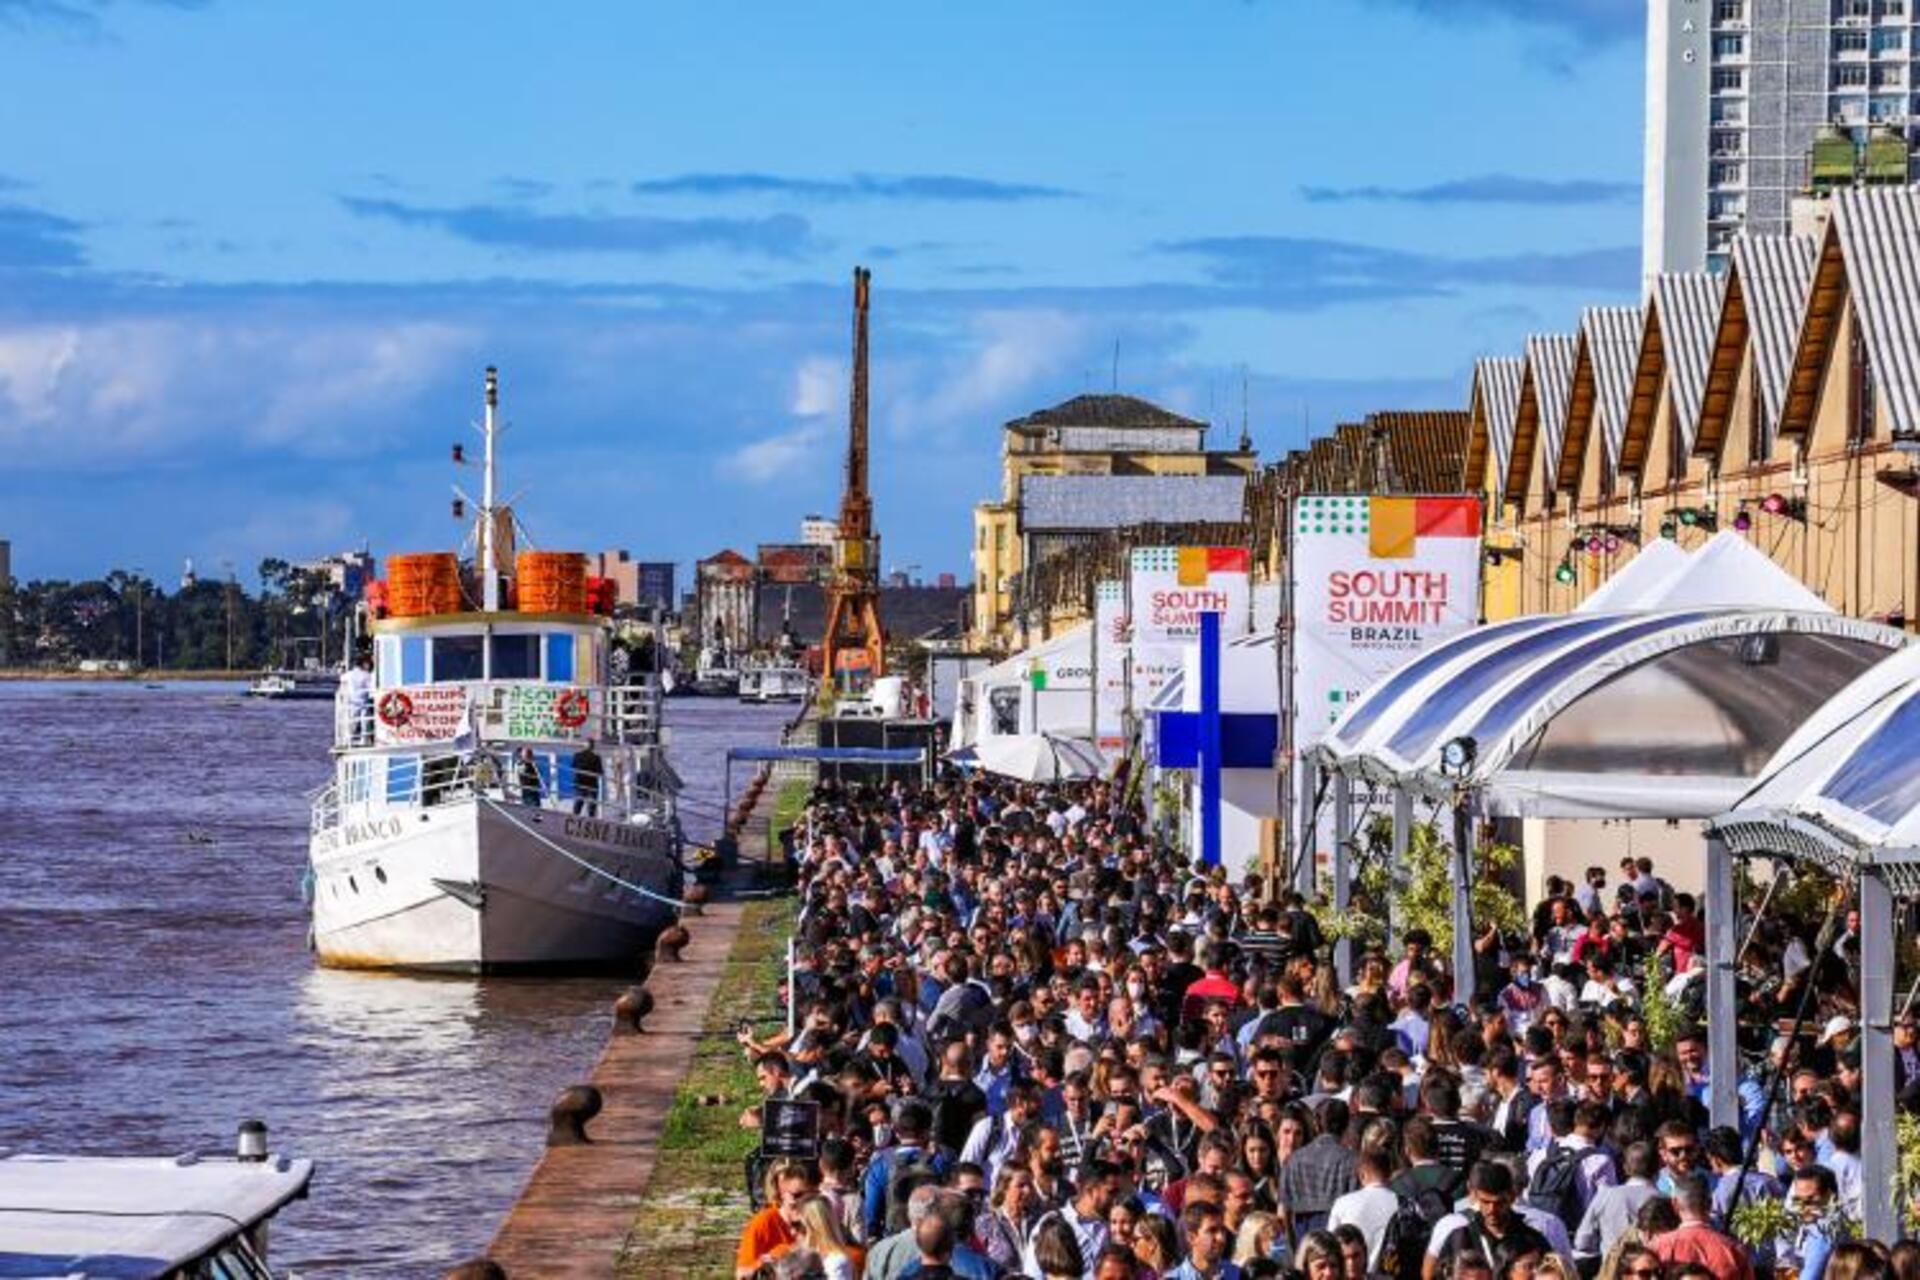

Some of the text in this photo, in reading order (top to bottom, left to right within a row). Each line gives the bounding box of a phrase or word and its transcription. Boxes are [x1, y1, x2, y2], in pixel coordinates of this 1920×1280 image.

[1329, 571, 1448, 599] SOUTH
[1152, 591, 1227, 609] SOUTH
[1328, 600, 1448, 625] SUMMIT
[1351, 627, 1423, 641] BRAZIL
